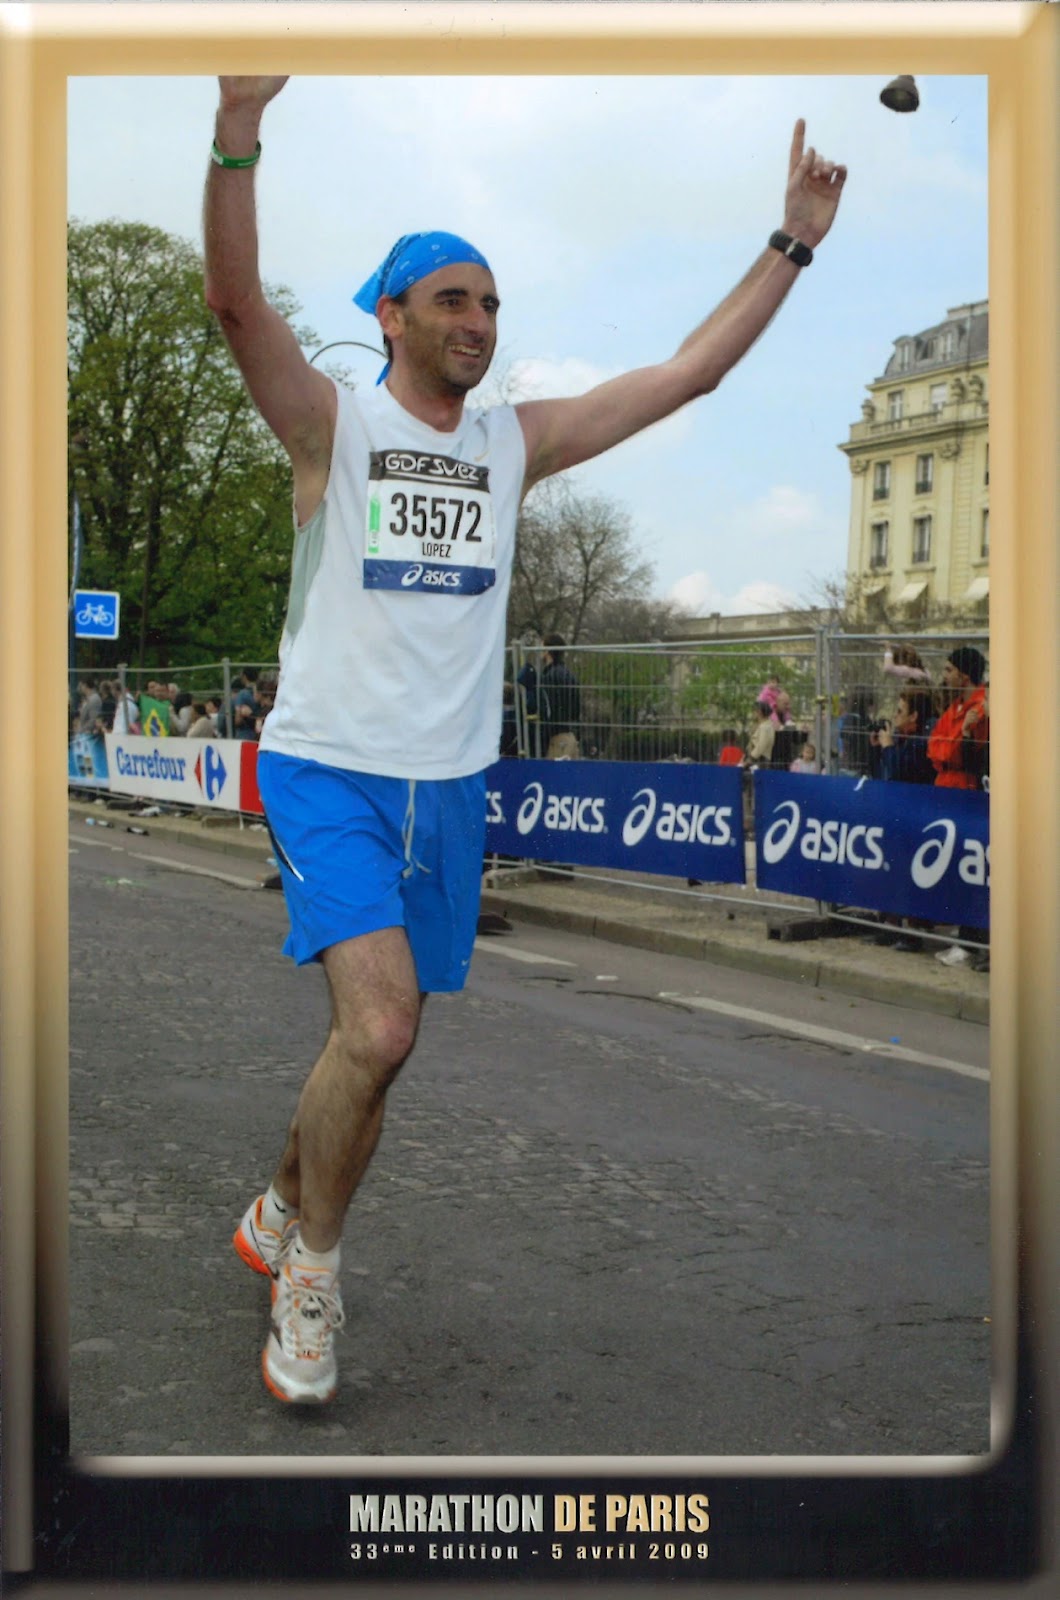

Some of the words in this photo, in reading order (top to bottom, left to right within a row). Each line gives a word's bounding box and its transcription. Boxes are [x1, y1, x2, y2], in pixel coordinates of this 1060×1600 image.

[385, 453, 430, 472] GDF
[389, 492, 482, 543] 35572
[422, 542, 452, 558] LOPEZ
[116, 746, 186, 782] Carrefour
